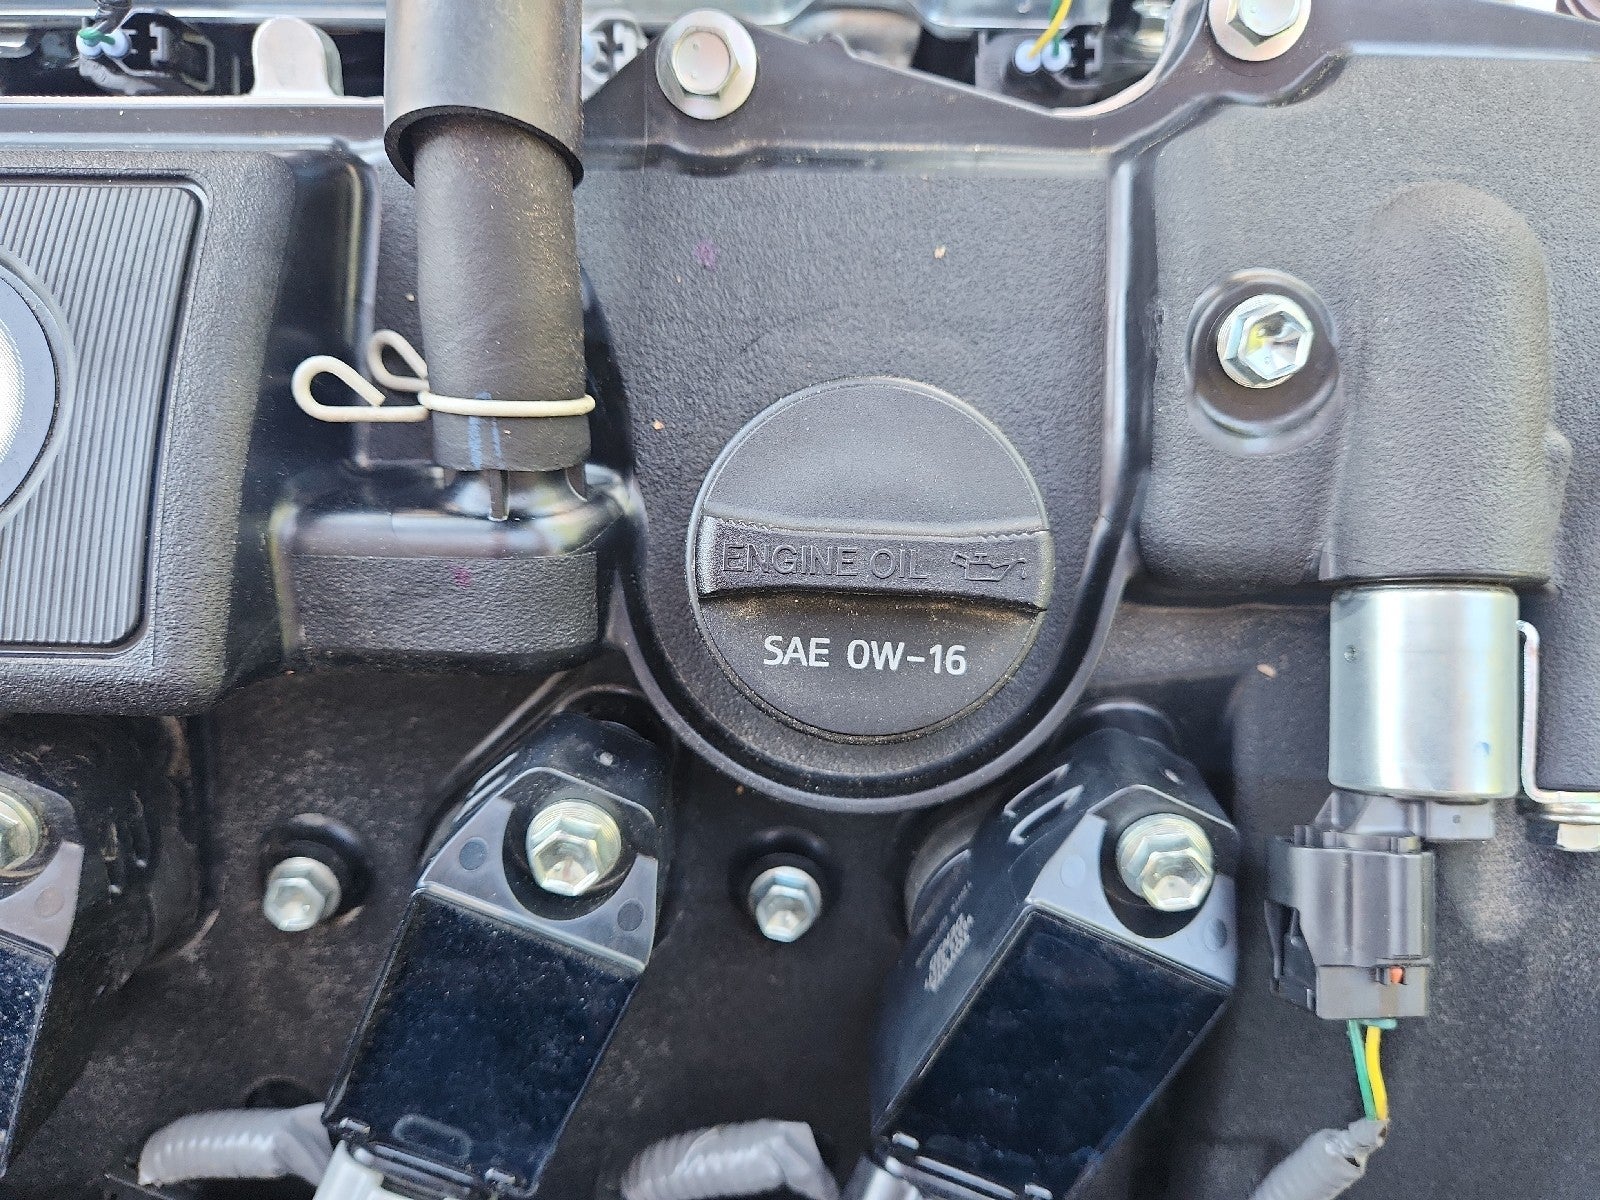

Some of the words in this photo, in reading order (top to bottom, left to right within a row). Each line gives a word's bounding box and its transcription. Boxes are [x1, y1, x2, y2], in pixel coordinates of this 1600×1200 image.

[721, 544, 858, 578] ENGINE
[869, 548, 928, 580] OIL
[763, 636, 831, 668] SAE
[847, 639, 967, 675] 0W-16
